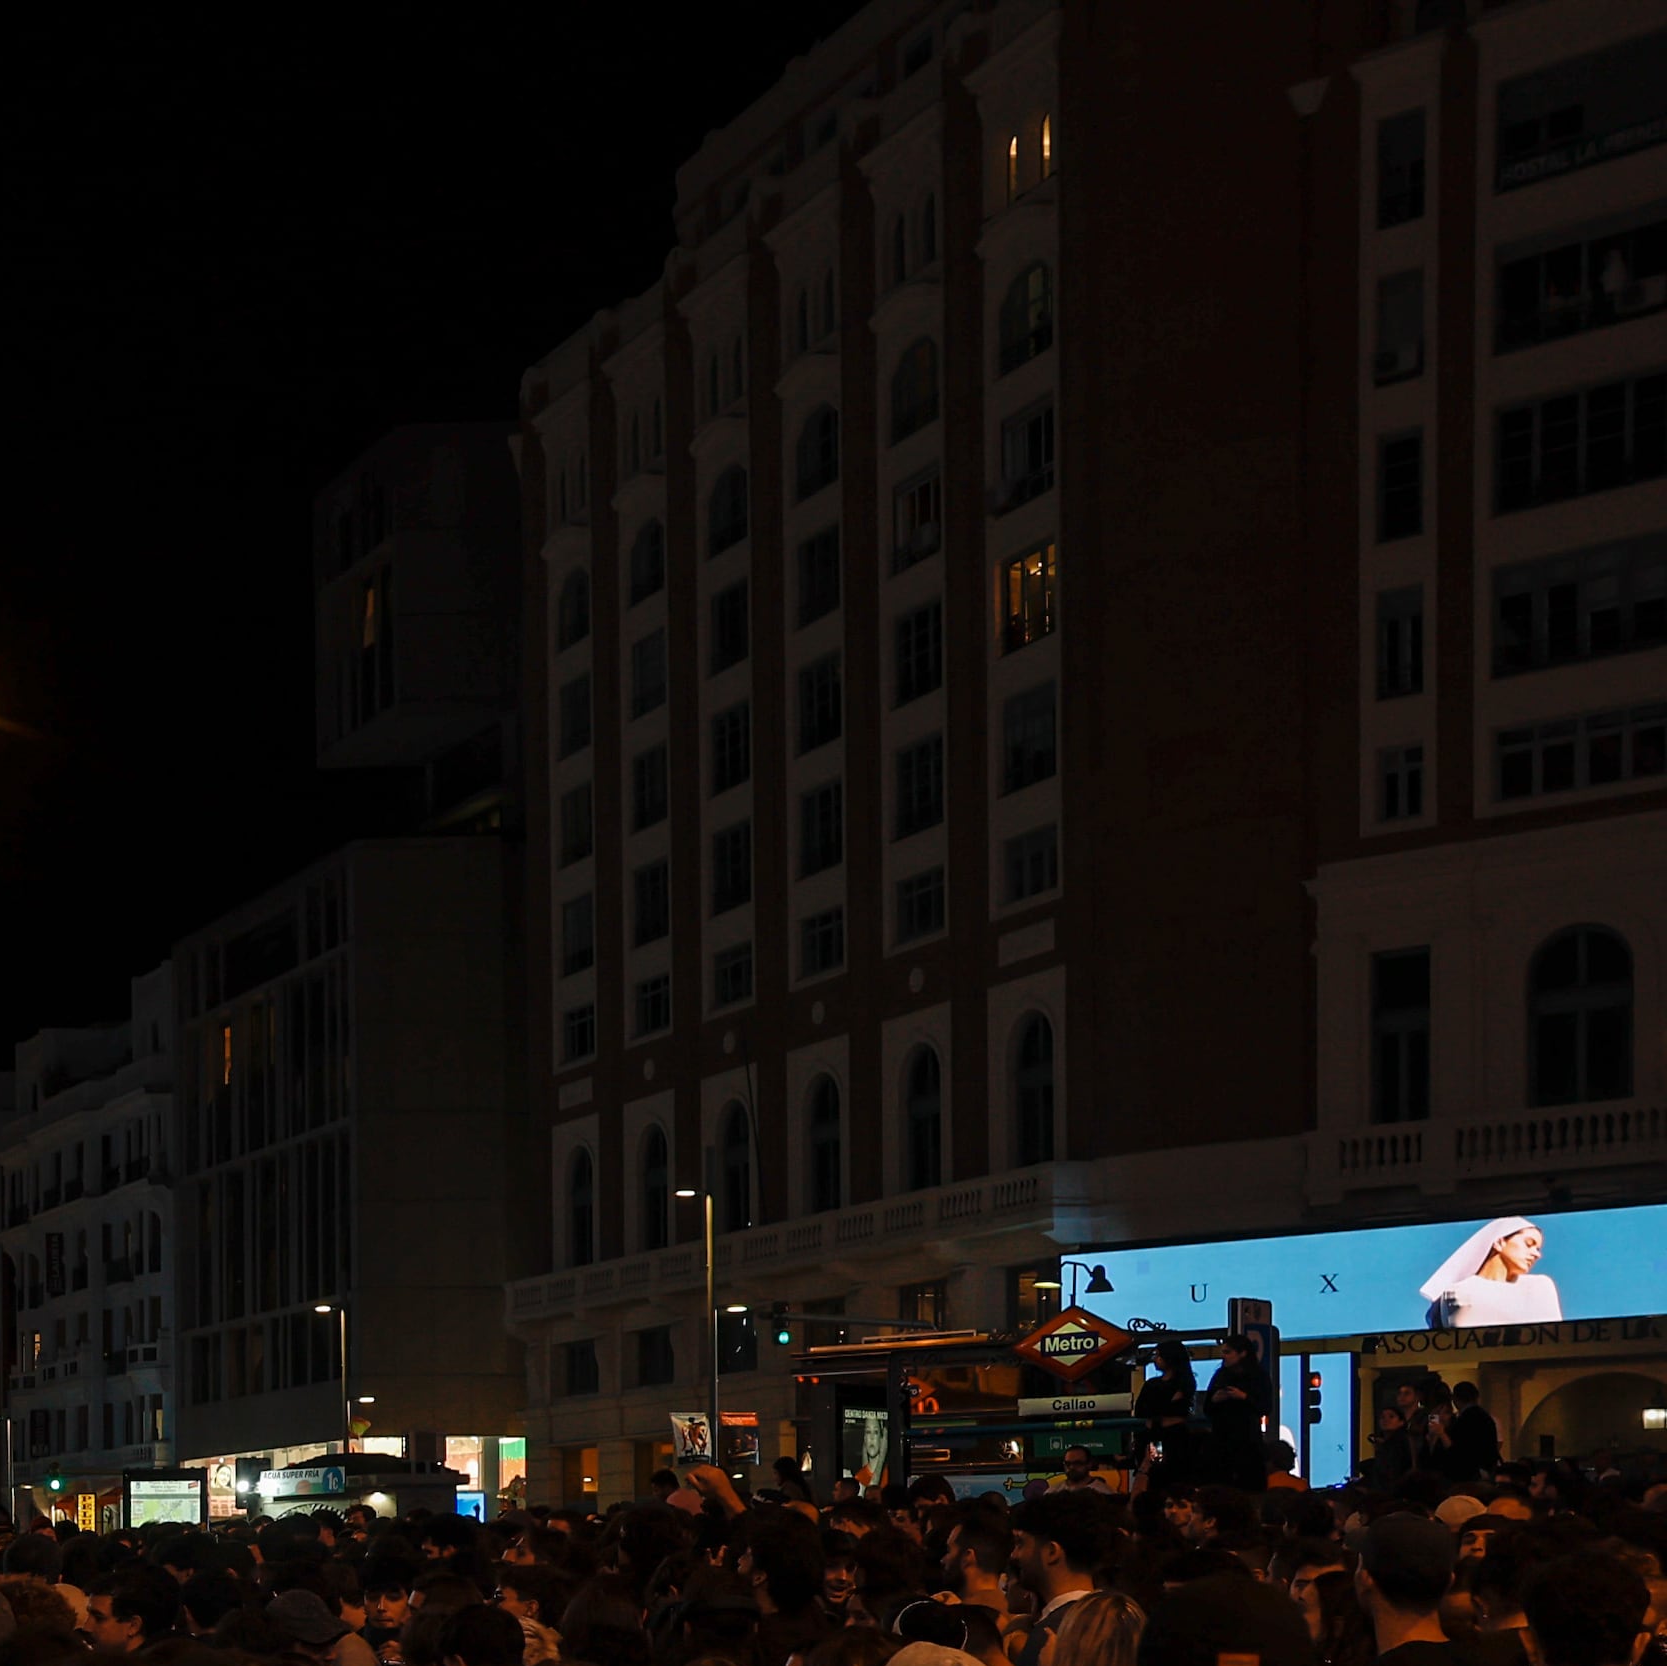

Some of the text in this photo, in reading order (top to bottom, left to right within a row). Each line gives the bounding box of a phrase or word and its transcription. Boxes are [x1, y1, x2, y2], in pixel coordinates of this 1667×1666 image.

[1190, 1273, 1339, 1303] U X
[1044, 1335, 1096, 1353] Metro
[1052, 1398, 1096, 1411] Callao
